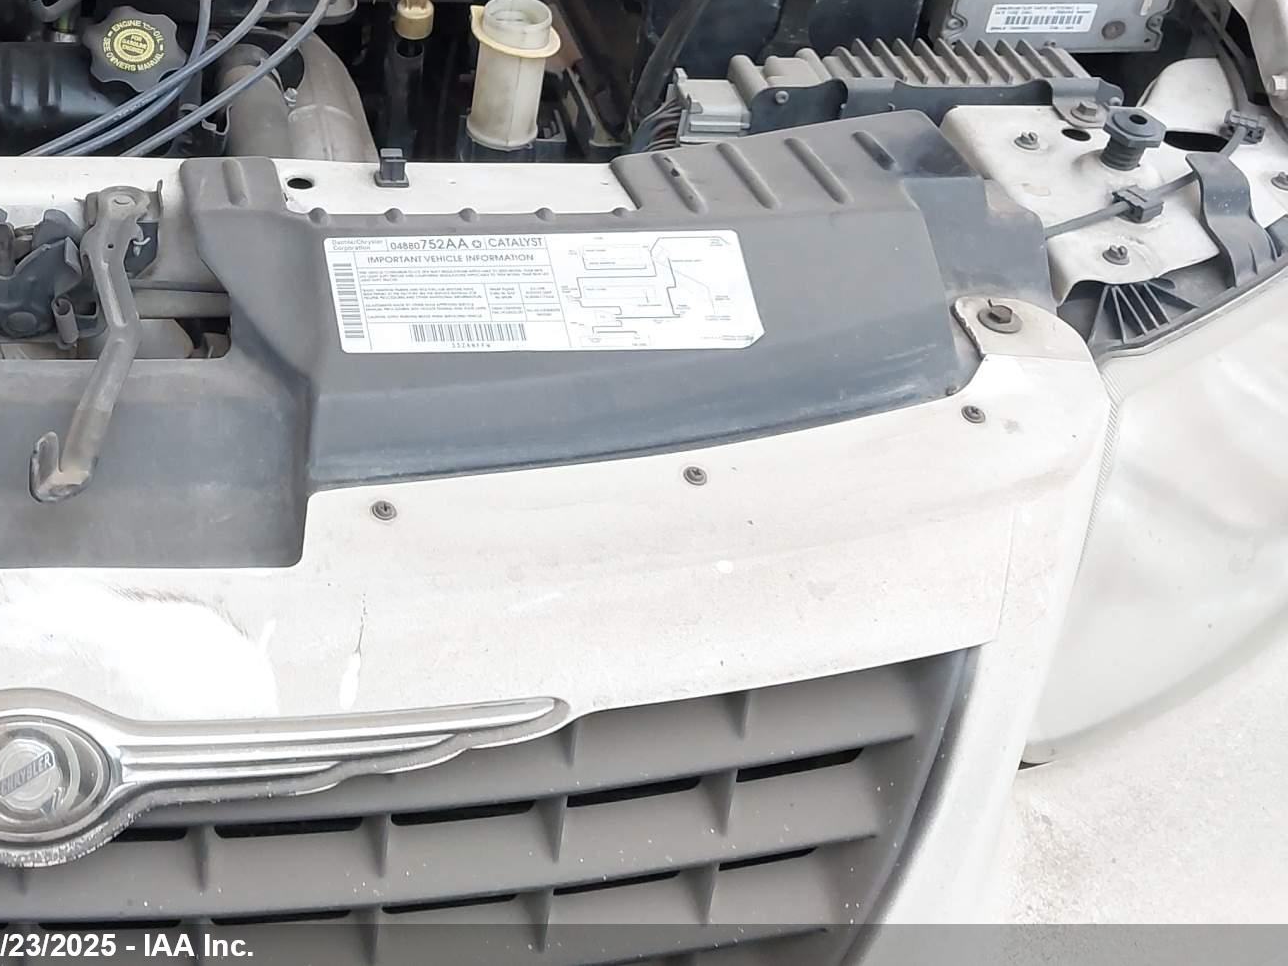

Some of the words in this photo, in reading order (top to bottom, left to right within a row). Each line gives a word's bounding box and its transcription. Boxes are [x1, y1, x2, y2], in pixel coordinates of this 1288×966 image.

[112, 19, 141, 32] ENGINE
[153, 30, 164, 43] OIL
[103, 37, 111, 53] SEE
[106, 52, 136, 71] OWNERS
[137, 52, 164, 71] MANUAL
[488, 237, 543, 247] CATALYST
[367, 255, 422, 264] IMPORTANT
[423, 254, 463, 263] VEHICLE
[465, 253, 534, 263] INFORMATION
